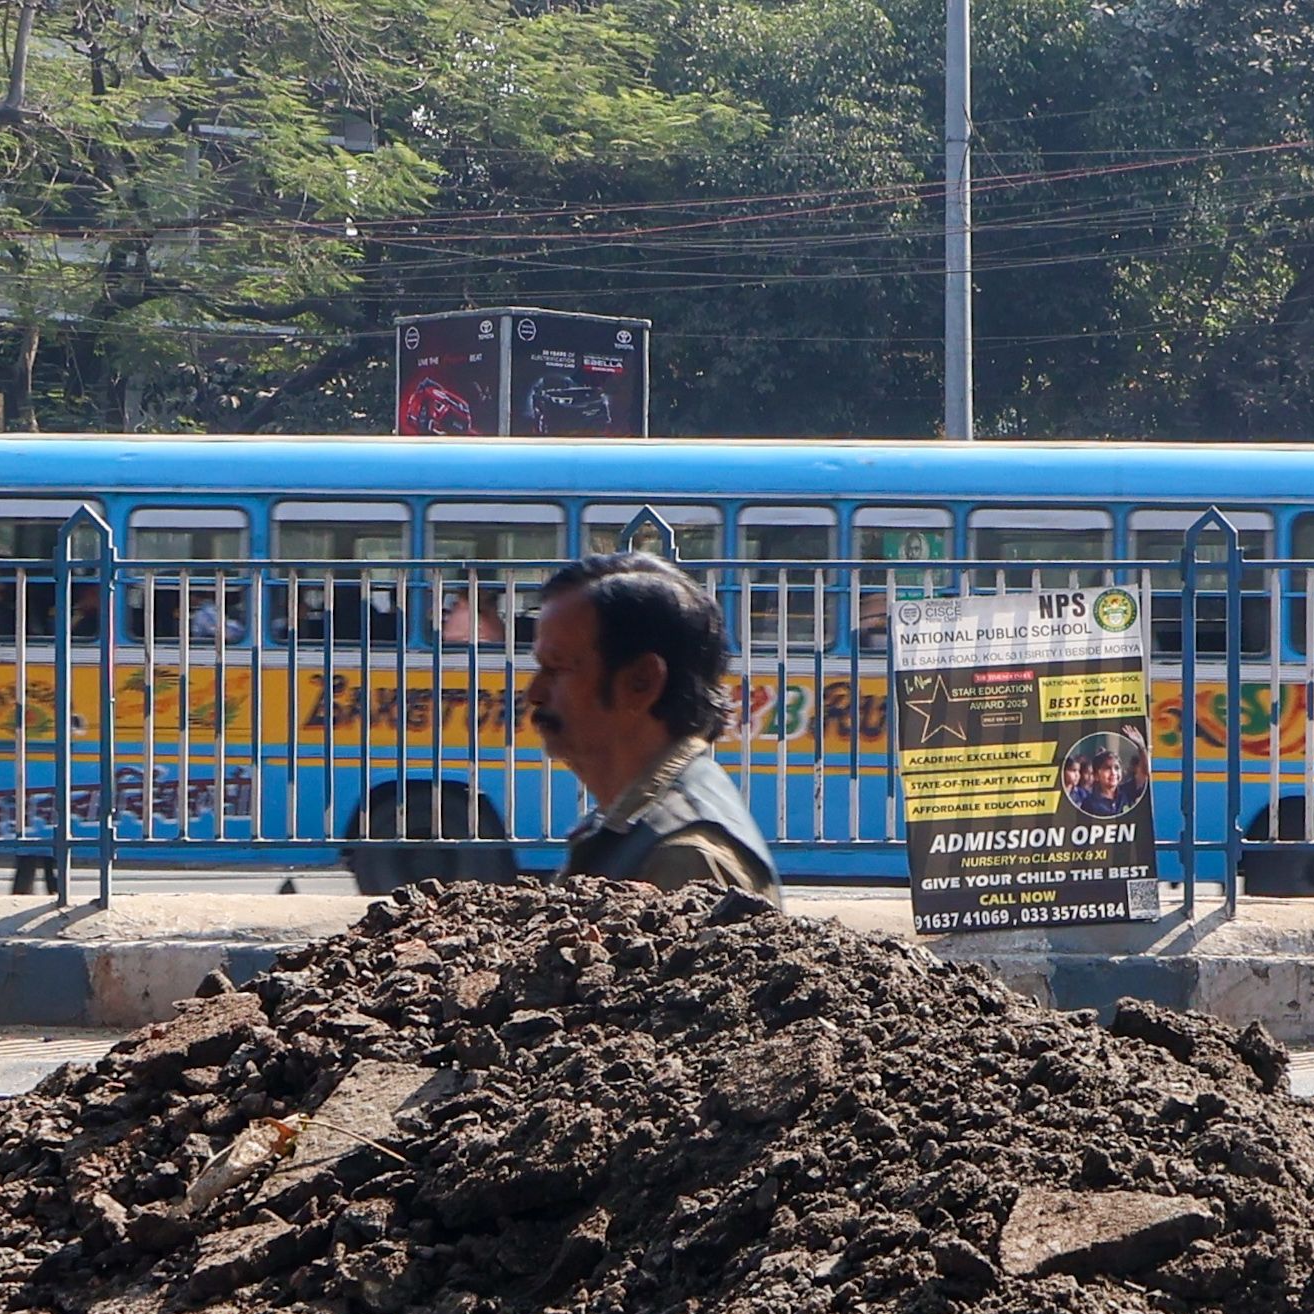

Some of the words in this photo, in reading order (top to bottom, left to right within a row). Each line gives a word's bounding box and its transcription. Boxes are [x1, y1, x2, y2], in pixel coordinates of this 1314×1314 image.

[925, 607, 962, 618] CISCE
[1039, 592, 1086, 619] NPS
[900, 630, 973, 645] NATIONAL
[976, 626, 1028, 641] PUBLIC
[1031, 623, 1092, 637] SCHOOL
[902, 658, 909, 666] B
[912, 657, 918, 666] L
[919, 656, 947, 665] SAHA
[948, 654, 981, 664] ROAD,
[983, 652, 1004, 662] KOL
[1005, 652, 1017, 661] 53
[1024, 649, 1058, 659] SIRITY
[1066, 646, 1102, 656] BESIDE
[1104, 644, 1141, 654] MORYA
[1042, 679, 1078, 687] NATIONAL
[1081, 677, 1109, 685] PUBLIC
[1110, 675, 1141, 683] SCHOOL
[951, 687, 976, 698] STAR
[978, 684, 1033, 696] EDUCATION
[969, 700, 1005, 711] AWARD
[1006, 699, 1028, 708] 2025
[1049, 697, 1081, 709] BEST
[1084, 693, 1138, 707] SCHOOL
[909, 755, 964, 766] ACADEMIC
[967, 751, 1031, 762] EXCELLENCE
[911, 776, 1004, 790] STATE-OF-THE-ART
[1007, 774, 1052, 785] FACILITY
[912, 803, 981, 815] AFFORDABLE
[984, 799, 1046, 810] EDUCATION
[929, 827, 1065, 854] ADMISSION
[1071, 823, 1136, 846] OPEN
[961, 854, 1017, 868] NURSERY
[1032, 851, 1071, 863] CLASS
[1072, 851, 1083, 861] IX
[1084, 850, 1093, 861] &
[1094, 849, 1107, 860] XI
[921, 876, 960, 890] GIVE
[965, 873, 1012, 887] YOUR
[1016, 870, 1066, 884] CHILD
[1070, 868, 1104, 881] THE
[1108, 865, 1149, 879] BEST
[979, 893, 1016, 906] CALL
[1020, 890, 1056, 904] NOW
[914, 912, 959, 930] 91637
[963, 909, 1010, 926] 41069
[1020, 906, 1048, 922] 033
[1051, 902, 1125, 921] 35765184
